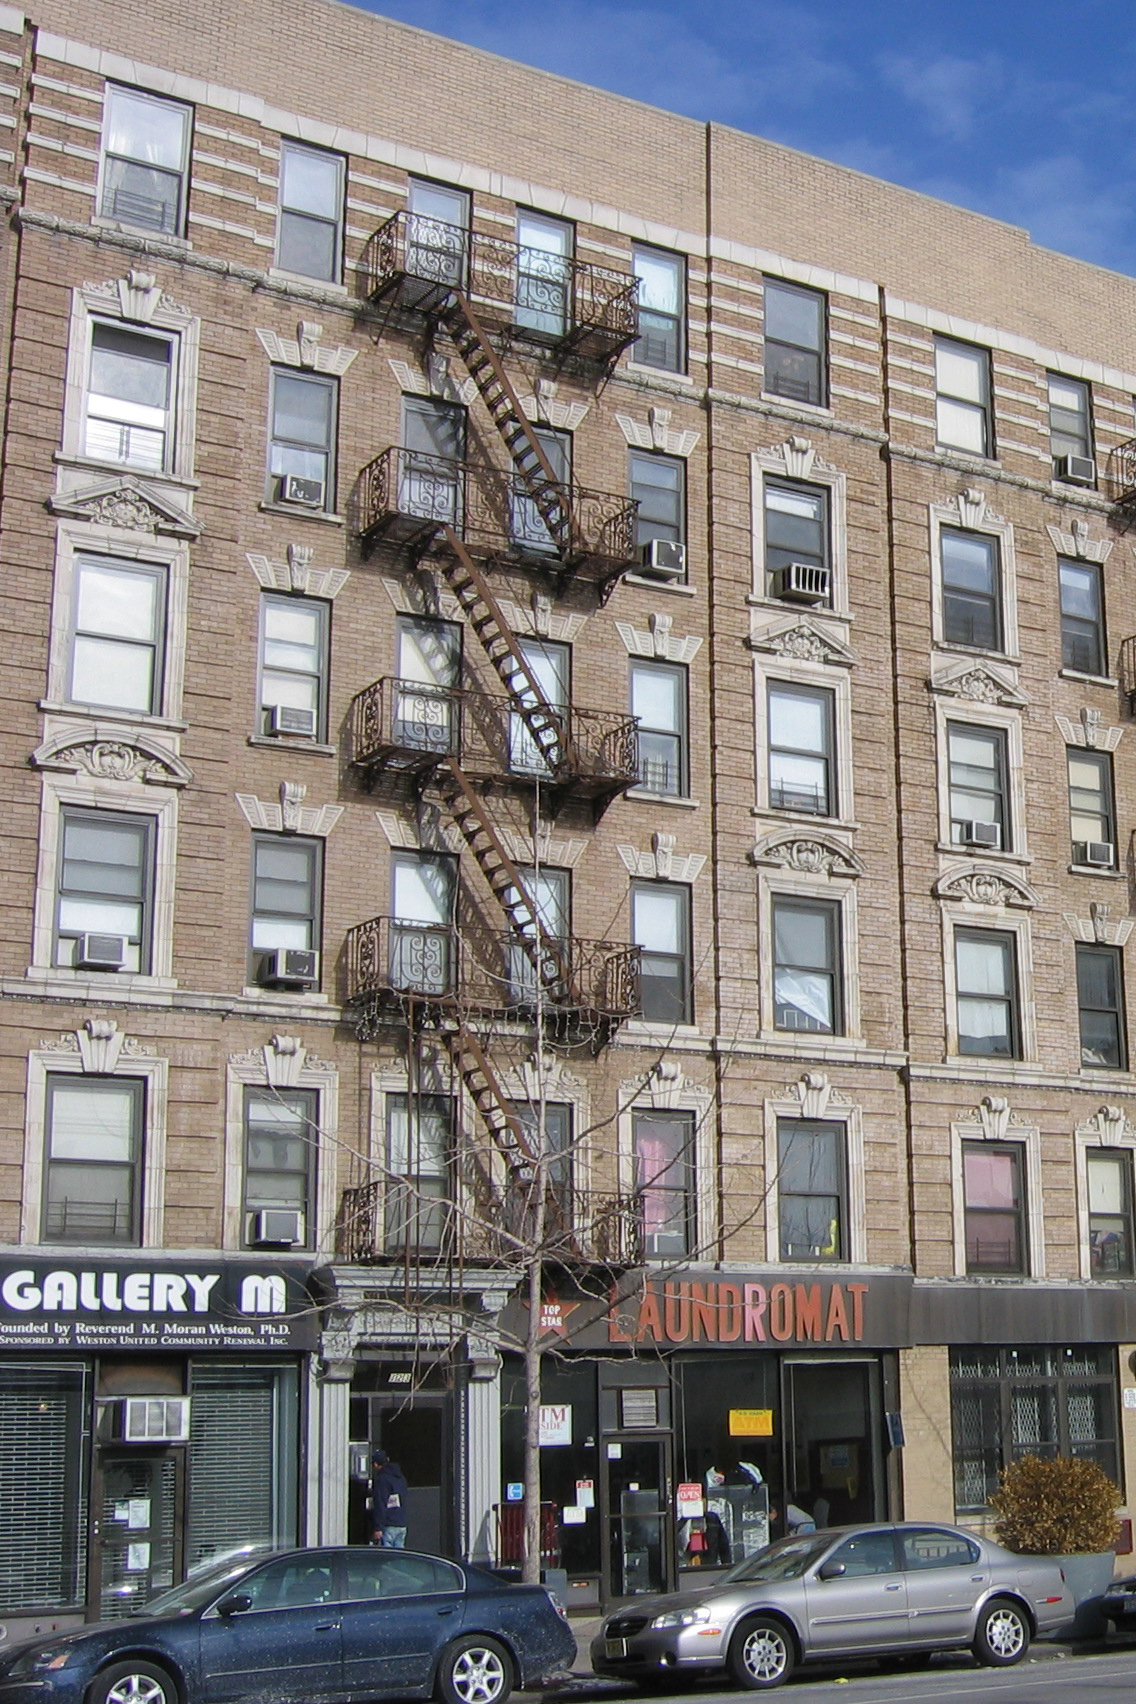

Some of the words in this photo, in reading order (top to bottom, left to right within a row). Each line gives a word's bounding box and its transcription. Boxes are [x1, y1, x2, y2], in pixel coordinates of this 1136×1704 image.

[2, 1270, 220, 1312] GALLERY
[241, 1274, 286, 1313] M
[543, 1305, 561, 1315] TOP
[609, 1282, 869, 1342] LAUNDROMAT
[541, 1316, 563, 1327] STAR
[54, 1322, 70, 1336] by
[75, 1322, 134, 1334] Reverend
[141, 1323, 159, 1334] M.
[163, 1323, 206, 1334] Moran
[208, 1323, 255, 1335] Weston,
[260, 1324, 291, 1335] Ph.D.
[540, 1407, 566, 1423] TM
[540, 1422, 563, 1431] SIDE
[680, 1491, 700, 1500] OPEN
